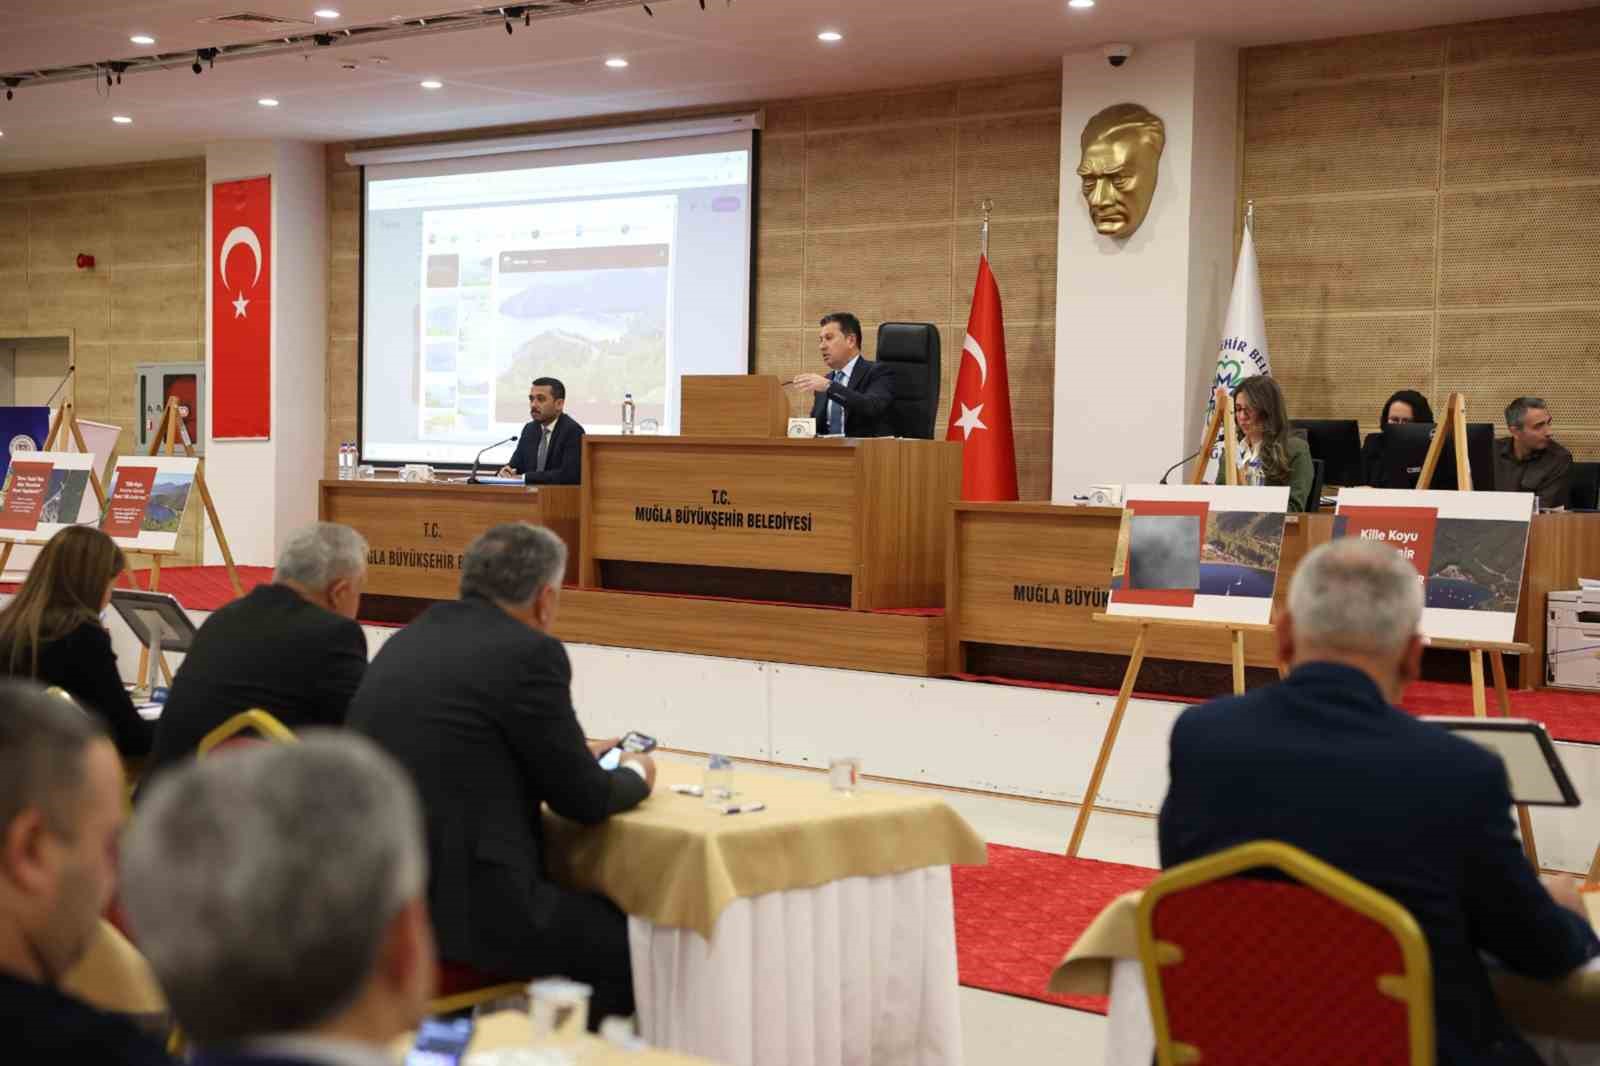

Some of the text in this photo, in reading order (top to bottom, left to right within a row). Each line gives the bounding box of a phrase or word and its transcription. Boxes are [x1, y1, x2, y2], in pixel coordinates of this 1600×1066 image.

[711, 489, 730, 505] T.C.
[635, 506, 812, 532] MUĞLA BÜYÜKŞEHİR BELEDİYESİ
[423, 522, 441, 538] T.C.
[1360, 529, 1418, 544] Kille Koyu
[389, 548, 454, 571] BÜYÜKŞEHİR
[1013, 583, 1060, 604] MUĞLA
